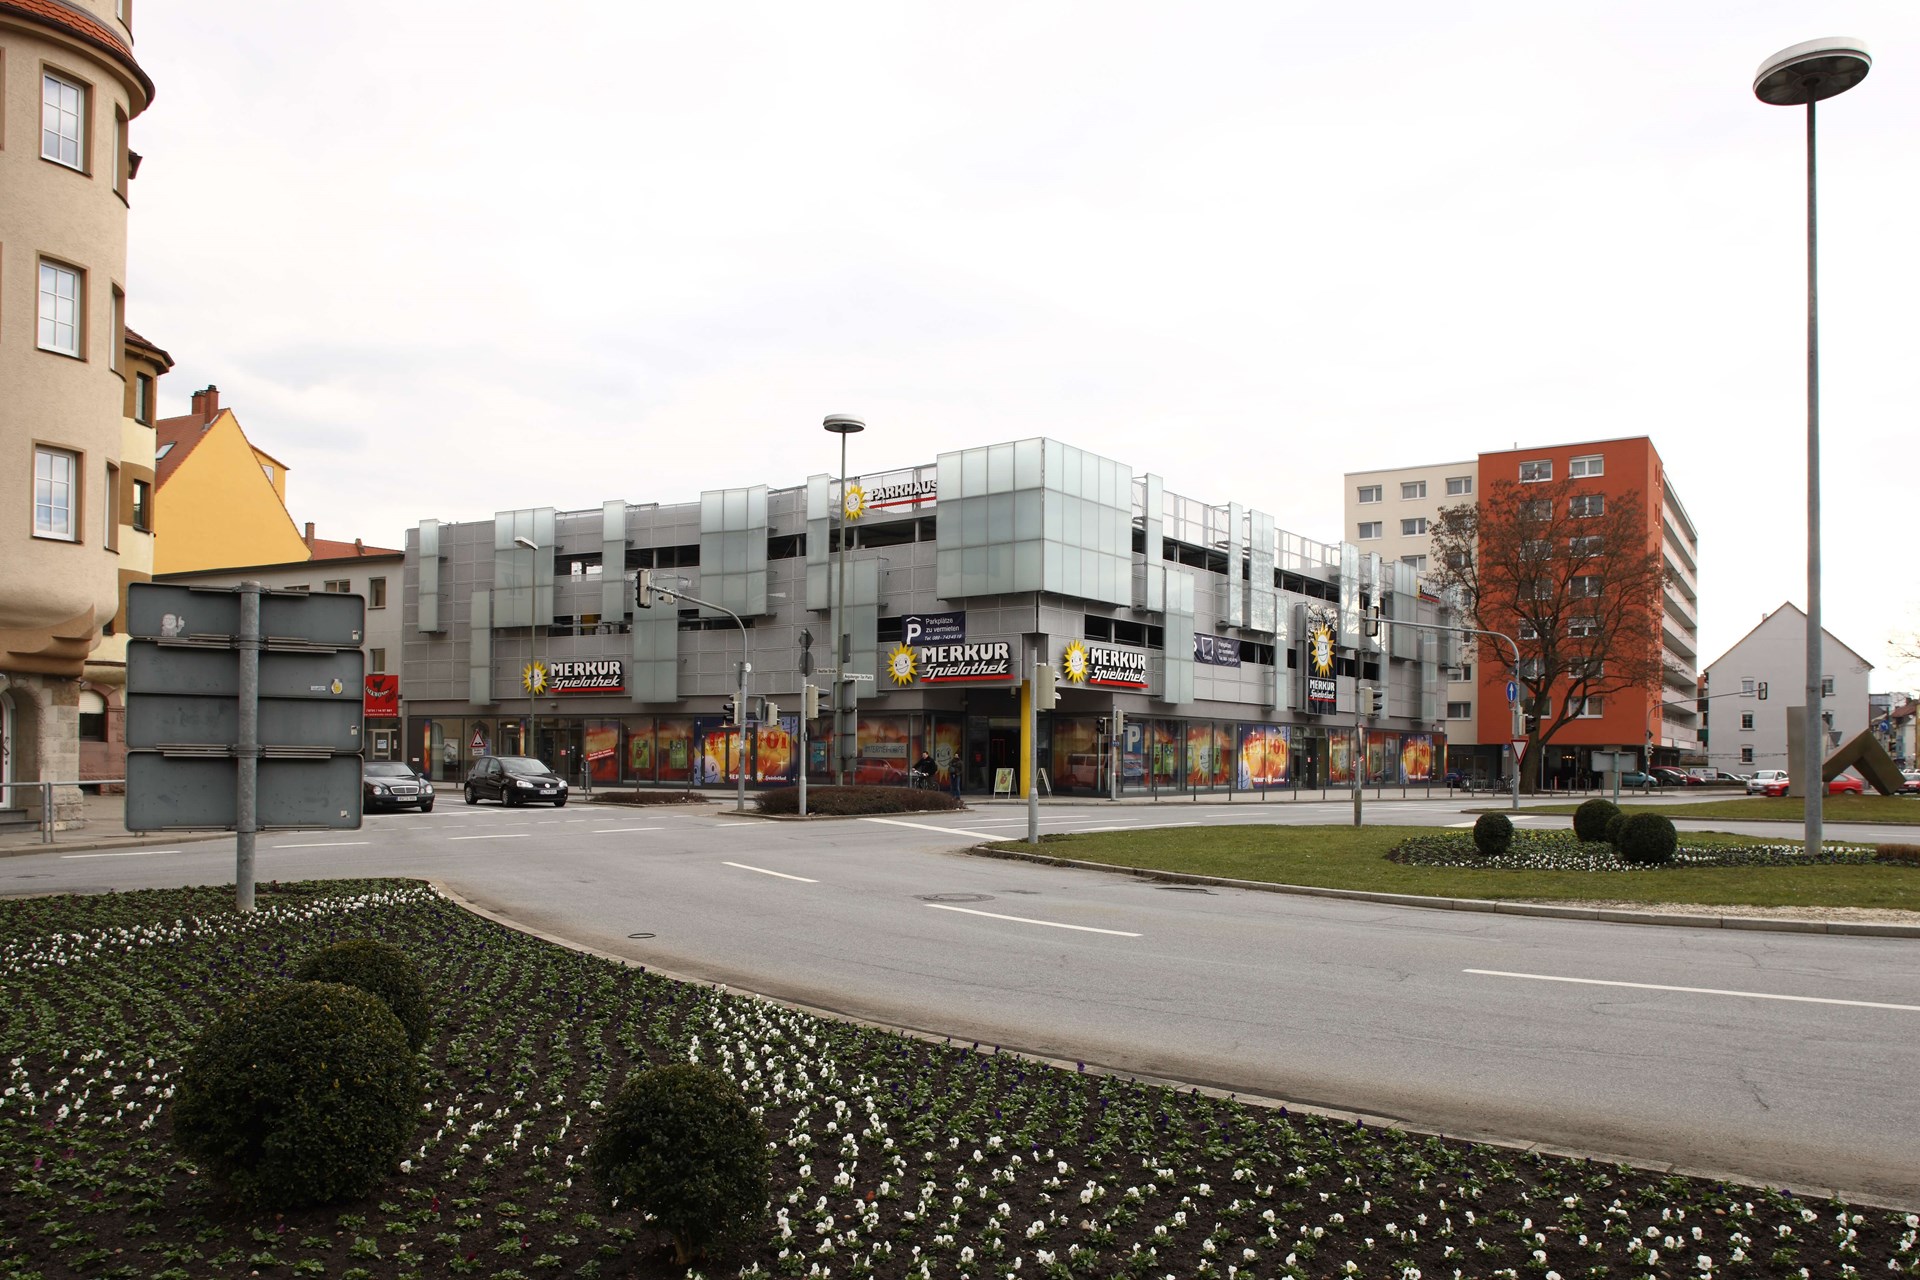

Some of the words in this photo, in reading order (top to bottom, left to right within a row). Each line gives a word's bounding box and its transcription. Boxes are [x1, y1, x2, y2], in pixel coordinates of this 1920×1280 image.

[871, 480, 937, 501] PARKHAUS
[925, 618, 953, 626] Parkplätze
[921, 643, 1009, 663] MERKUR
[1090, 648, 1146, 670] MERKUR
[550, 661, 621, 677] MERKUR
[922, 660, 1009, 680] Spielothek
[1091, 665, 1146, 683] Spielothek
[551, 675, 620, 691] Spielothek
[1309, 679, 1335, 692] MERKUR
